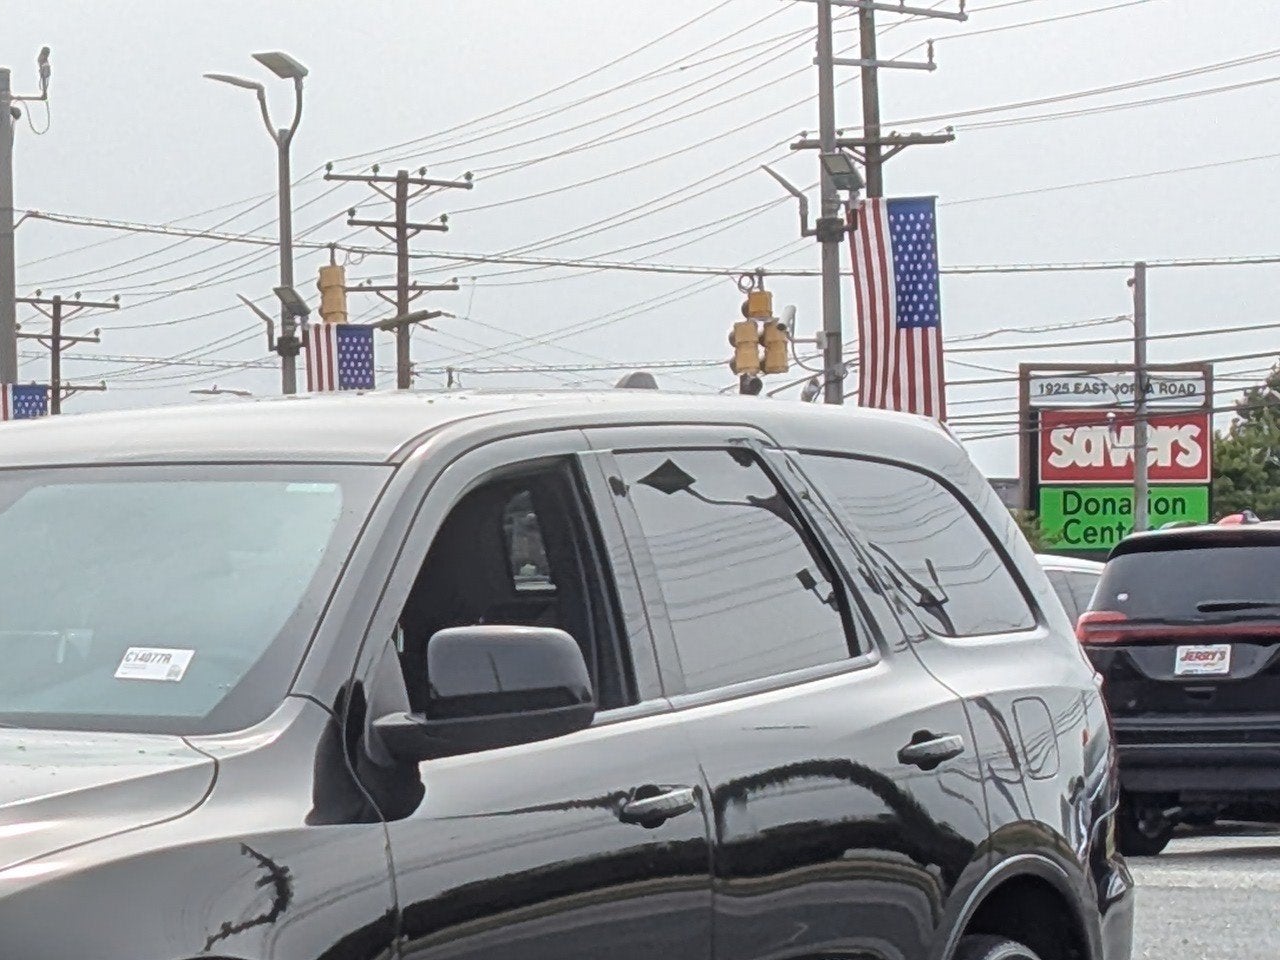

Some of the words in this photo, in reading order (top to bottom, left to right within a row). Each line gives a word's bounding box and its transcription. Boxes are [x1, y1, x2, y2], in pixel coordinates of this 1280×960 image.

[1038, 382, 1070, 395] 1925
[1072, 382, 1108, 395] EAST
[1112, 382, 1155, 395] JOPA
[1159, 382, 1196, 395] ROAD
[1063, 490, 1186, 516] Donaion
